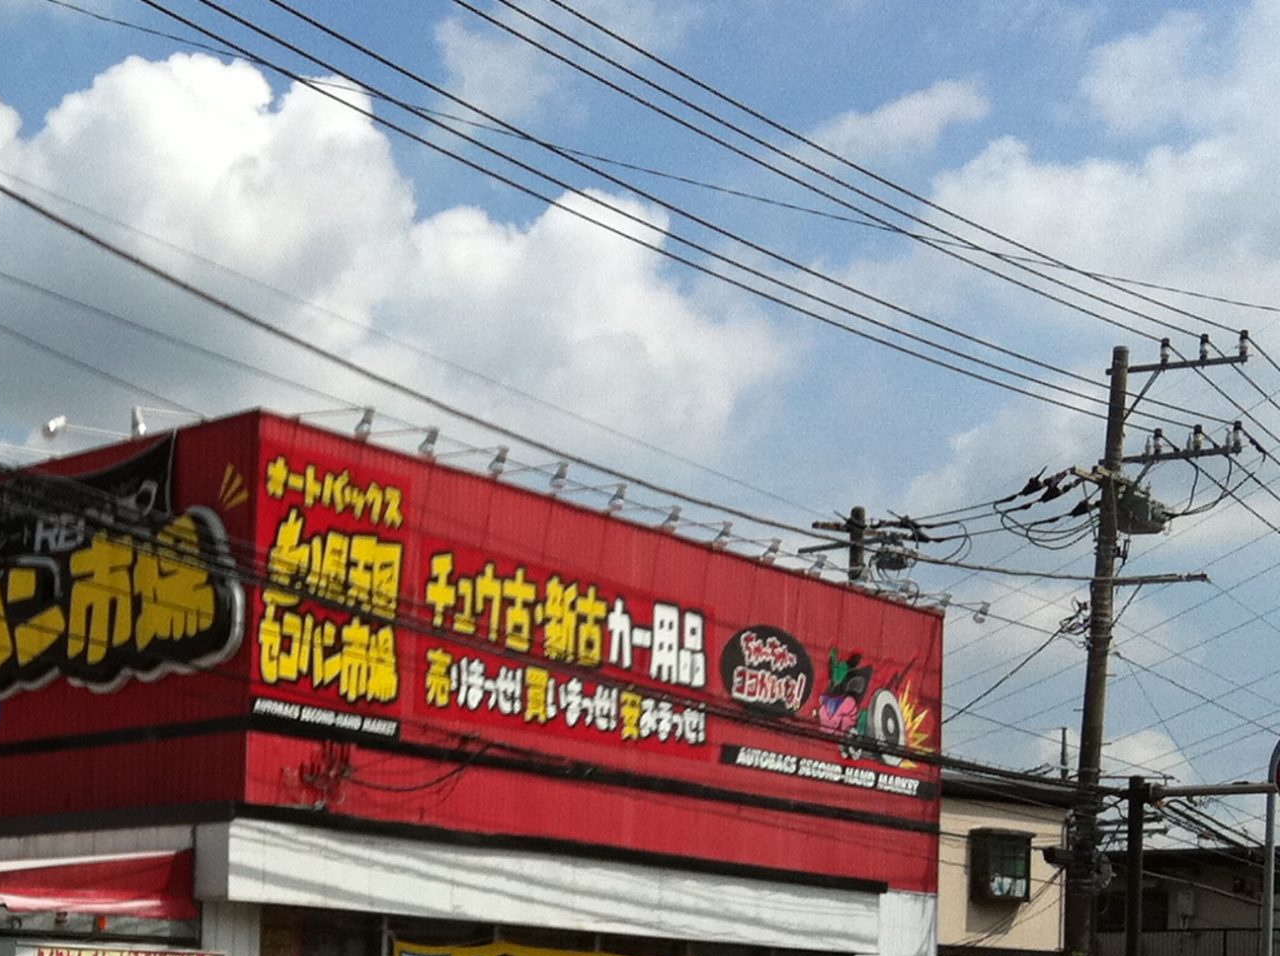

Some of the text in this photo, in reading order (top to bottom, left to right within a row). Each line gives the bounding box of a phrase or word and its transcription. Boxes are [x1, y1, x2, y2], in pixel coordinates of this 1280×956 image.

[266, 457, 403, 529] オートバックス
[258, 604, 399, 702] セコハン市場
[253, 698, 398, 737] AUTOBACS SECOND-HAND MARKET
[735, 746, 920, 796] AUTOBACS SECOND-HAND MARKET
